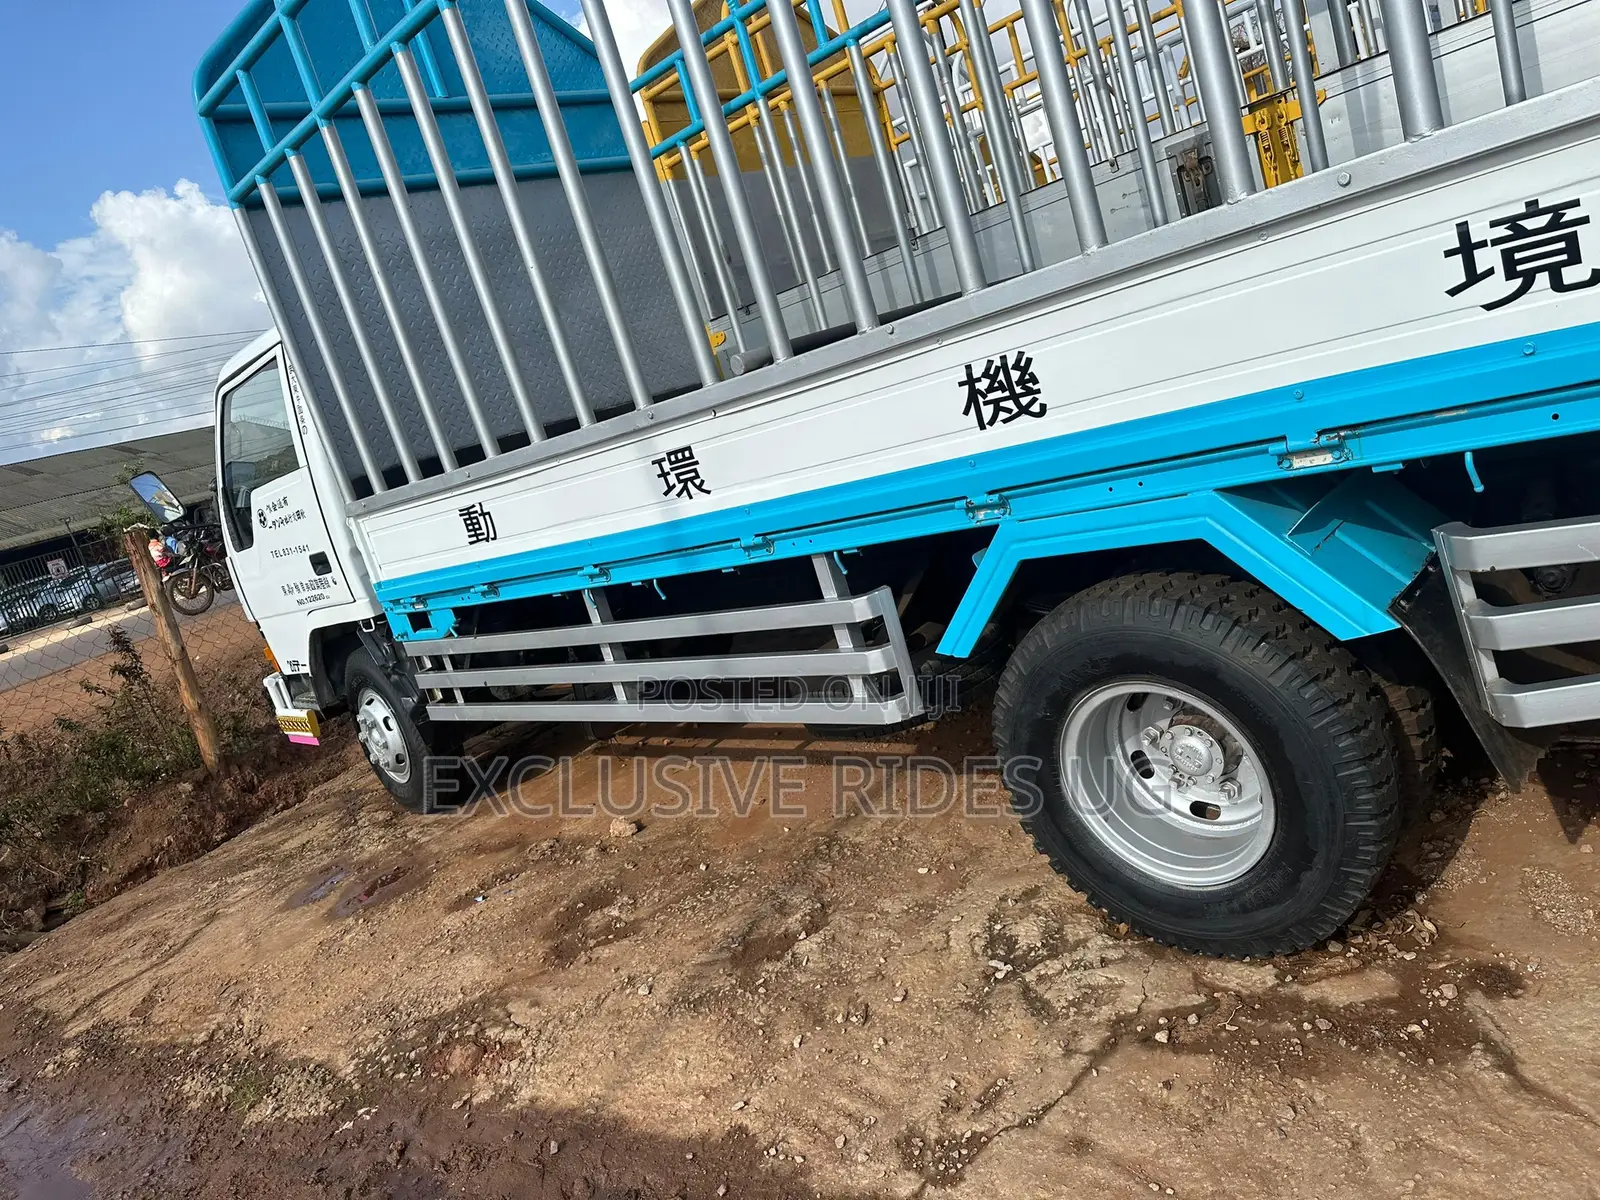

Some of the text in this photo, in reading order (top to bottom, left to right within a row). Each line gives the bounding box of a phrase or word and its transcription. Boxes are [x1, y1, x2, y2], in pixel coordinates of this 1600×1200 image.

[1443, 198, 1600, 312] 境
[958, 350, 1048, 431] 機
[651, 445, 712, 500] 環
[458, 502, 498, 546] 動
